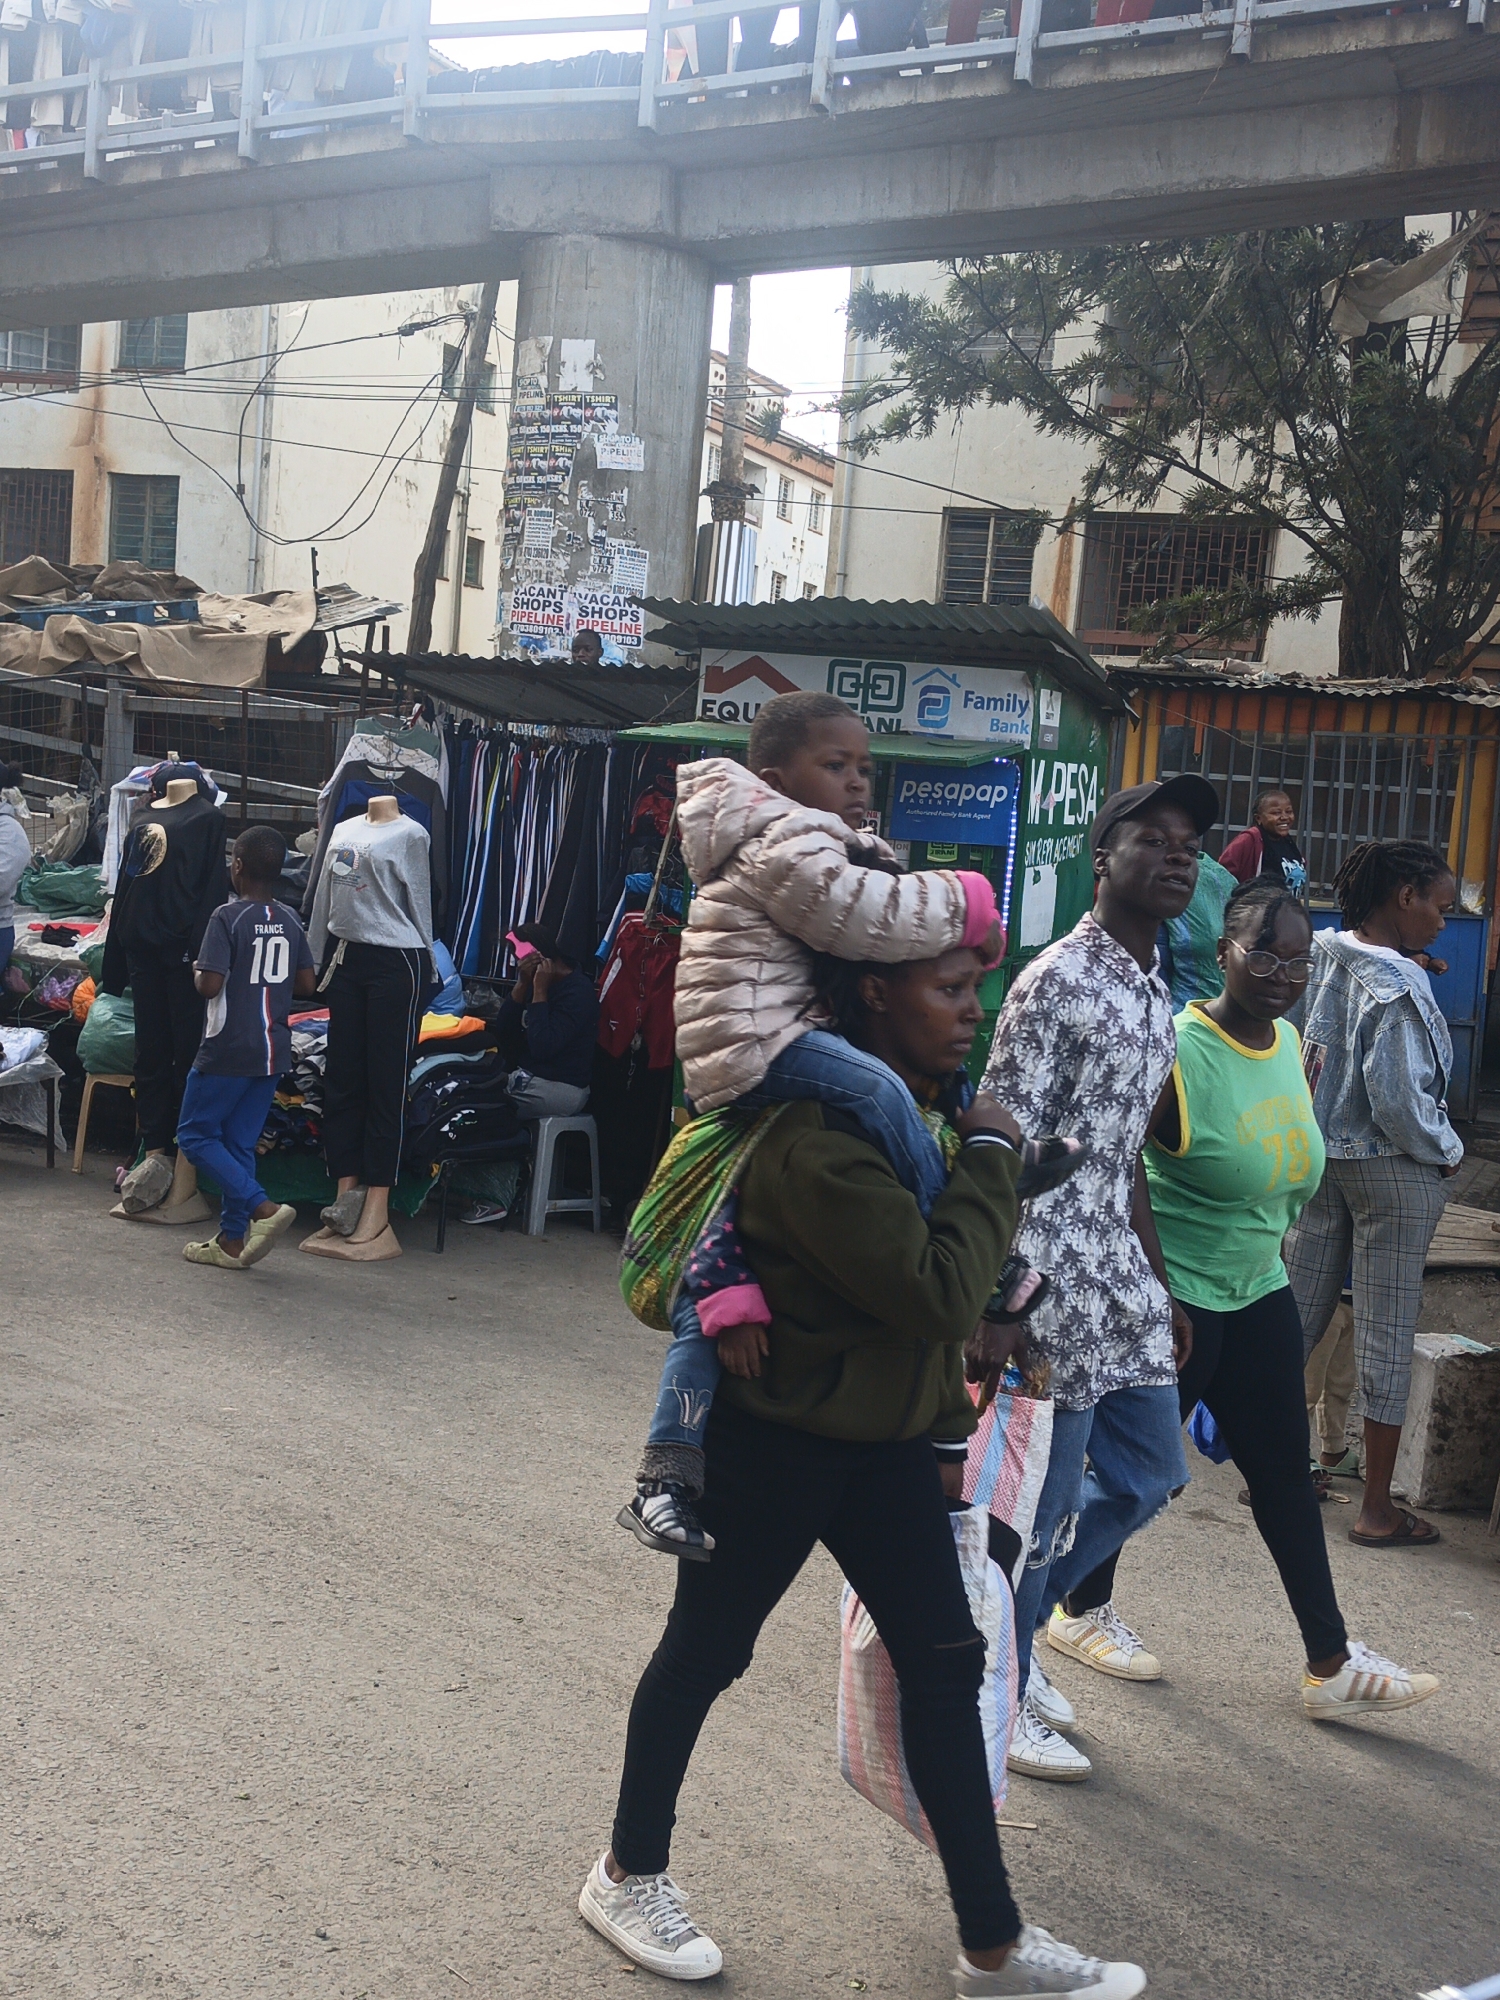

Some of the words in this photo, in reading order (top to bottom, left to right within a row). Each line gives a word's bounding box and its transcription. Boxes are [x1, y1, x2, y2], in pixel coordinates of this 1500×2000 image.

[553, 394, 582, 402] TSHIRT
[585, 395, 616, 403] TSHIRT
[514, 586, 568, 600] VACANT
[513, 597, 563, 614] SHOPS
[511, 610, 565, 626] PIPELINE
[578, 605, 640, 623] SHOPS
[576, 619, 642, 635] PIPELINE
[963, 690, 1030, 718] Family
[990, 718, 1029, 735] Bank
[899, 780, 1008, 808] pesapap
[909, 798, 950, 806] AGENT
[938, 811, 957, 819] Family
[254, 924, 284, 934] FRANCE
[250, 936, 290, 984] 10
[1261, 1127, 1311, 1192] 78
